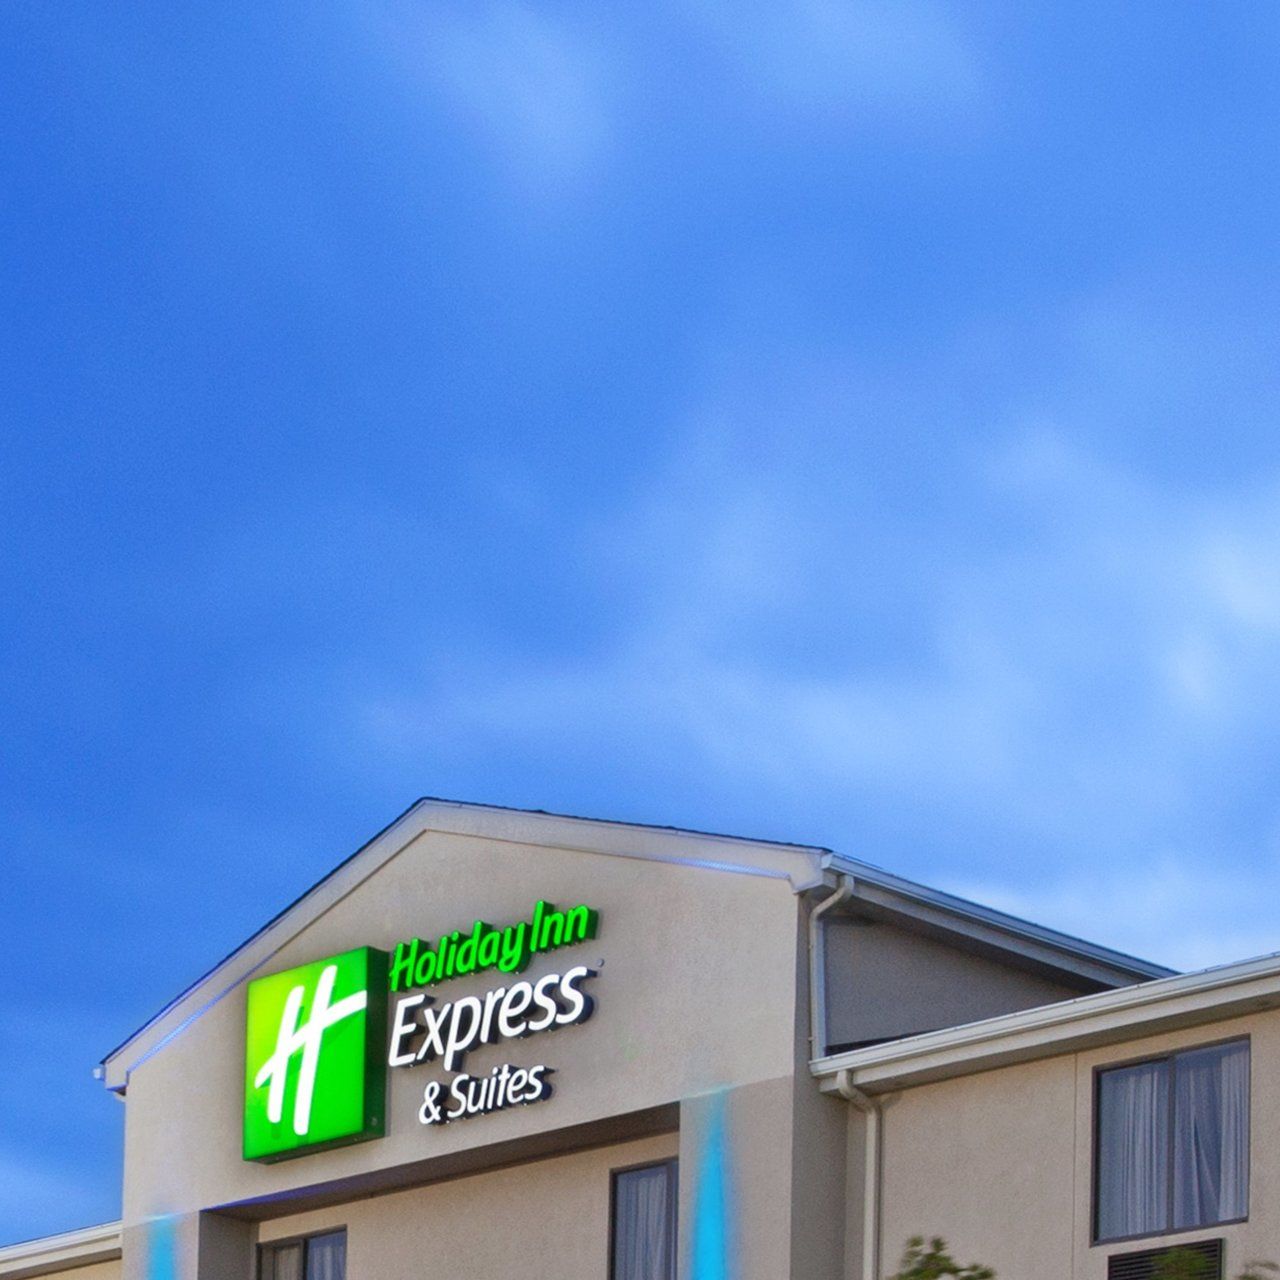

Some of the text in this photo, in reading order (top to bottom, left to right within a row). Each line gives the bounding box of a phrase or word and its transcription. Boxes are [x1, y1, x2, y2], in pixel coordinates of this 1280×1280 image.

[389, 901, 592, 992] Holiday Inn
[389, 966, 587, 1071] Express
[419, 1065, 545, 1125] & Suites
